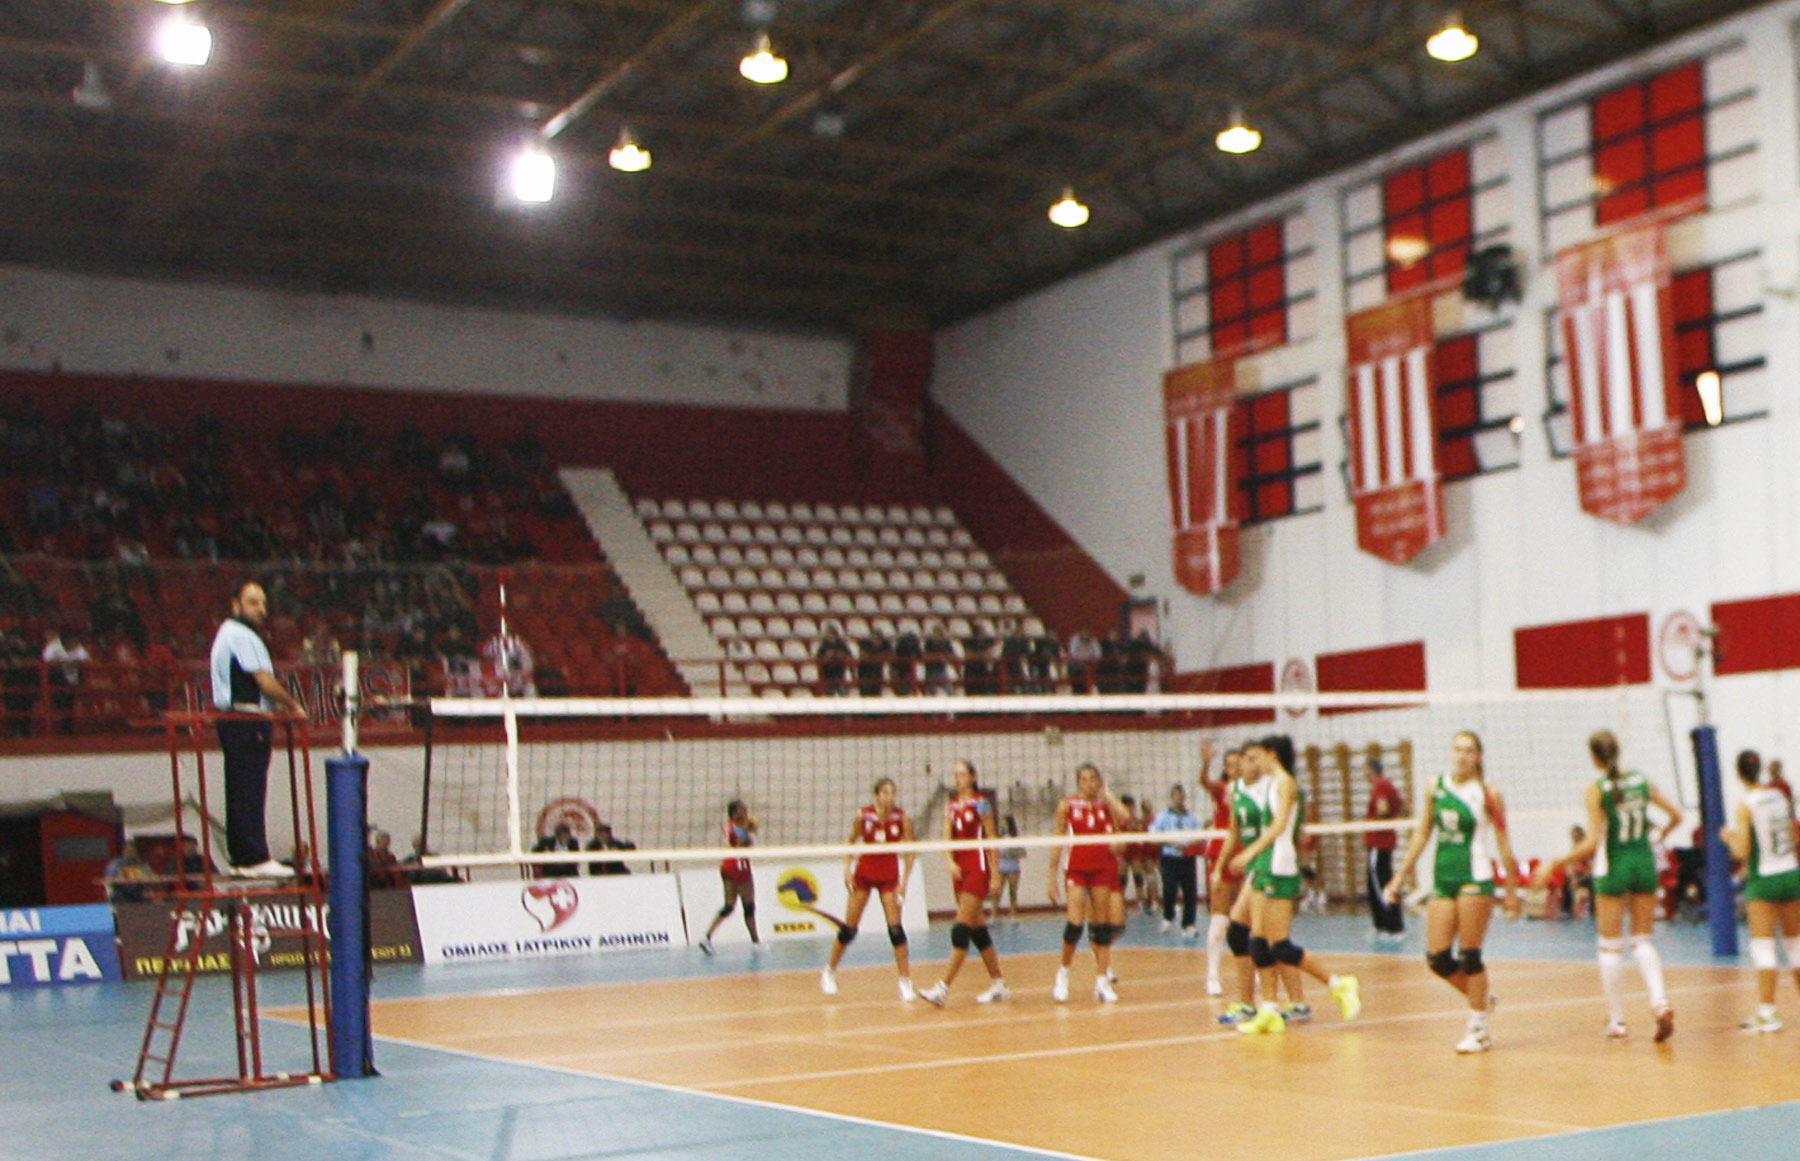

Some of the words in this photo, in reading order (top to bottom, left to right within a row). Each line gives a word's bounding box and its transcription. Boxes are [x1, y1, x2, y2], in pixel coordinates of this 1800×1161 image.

[442, 941, 510, 958] ΟΜΙΛΟΣ
[517, 936, 593, 953] ΙΑΤΡΙΚΟΥ
[599, 931, 670, 947] ΑΘΗΝΩΝ
